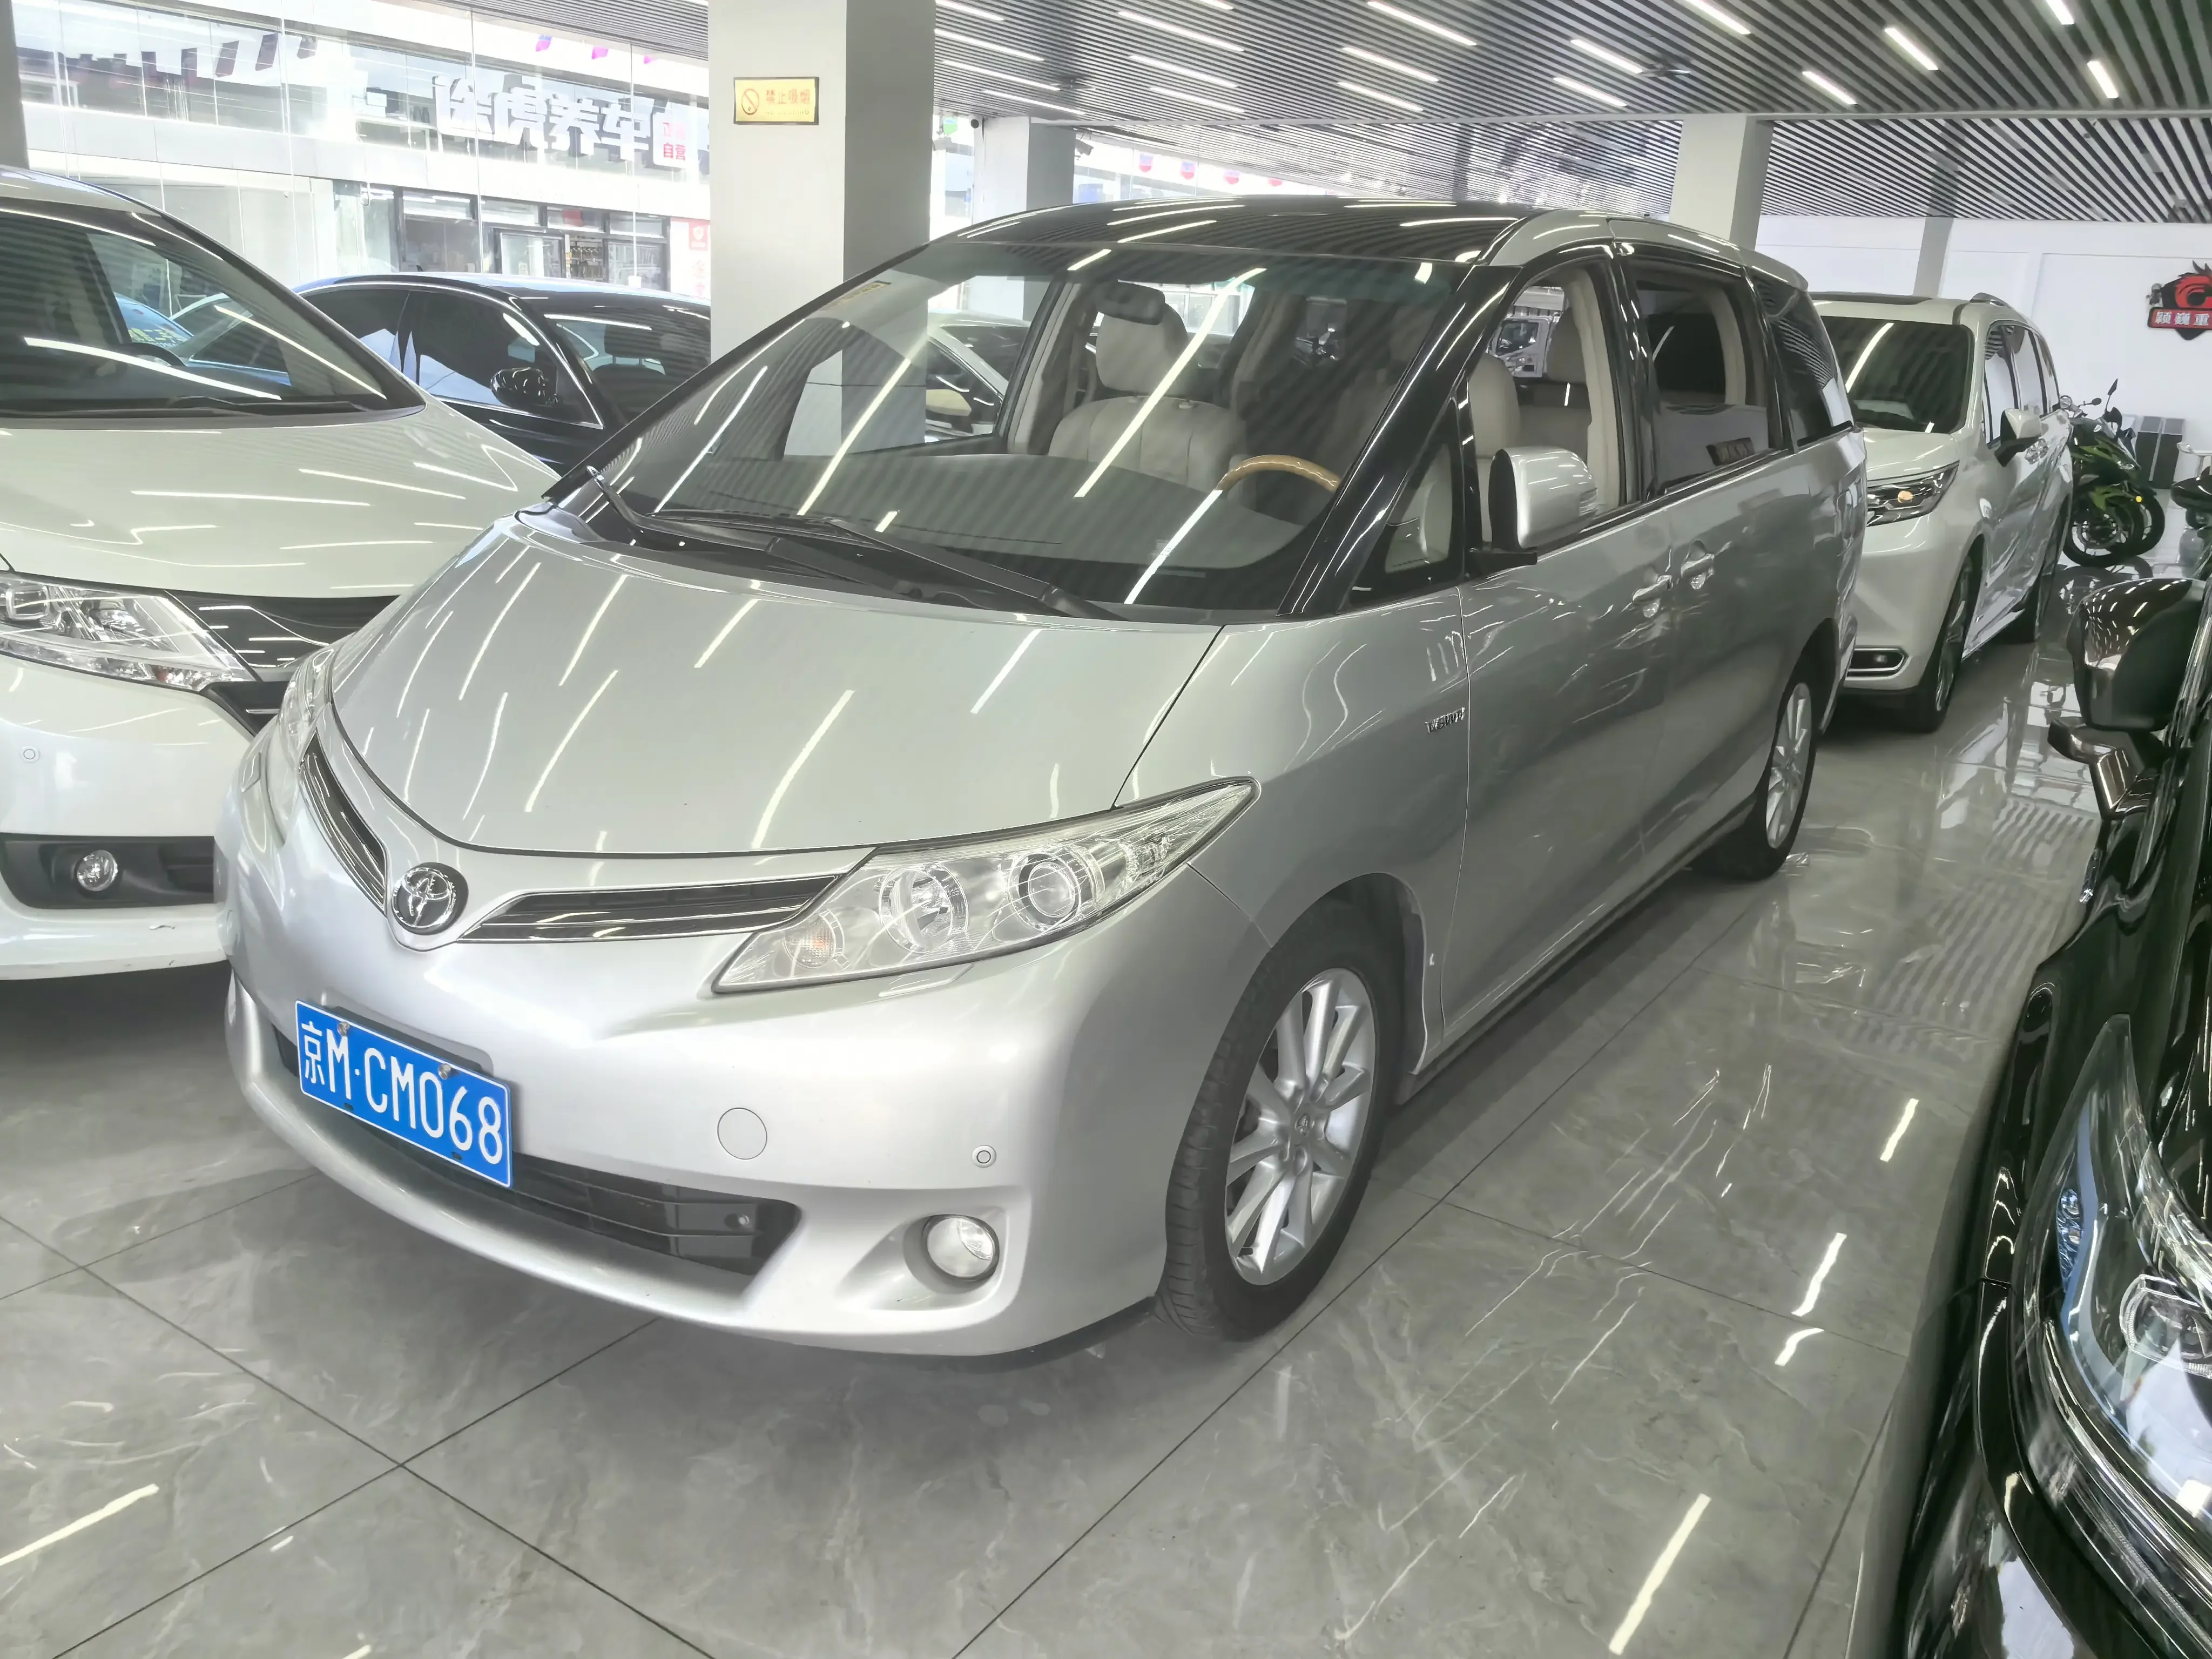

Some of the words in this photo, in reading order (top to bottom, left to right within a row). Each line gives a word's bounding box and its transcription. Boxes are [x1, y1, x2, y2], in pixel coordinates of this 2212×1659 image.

[765, 89, 810, 105] 禁止吸烟
[433, 75, 652, 162] 途虎养车
[663, 143, 686, 161] 自营
